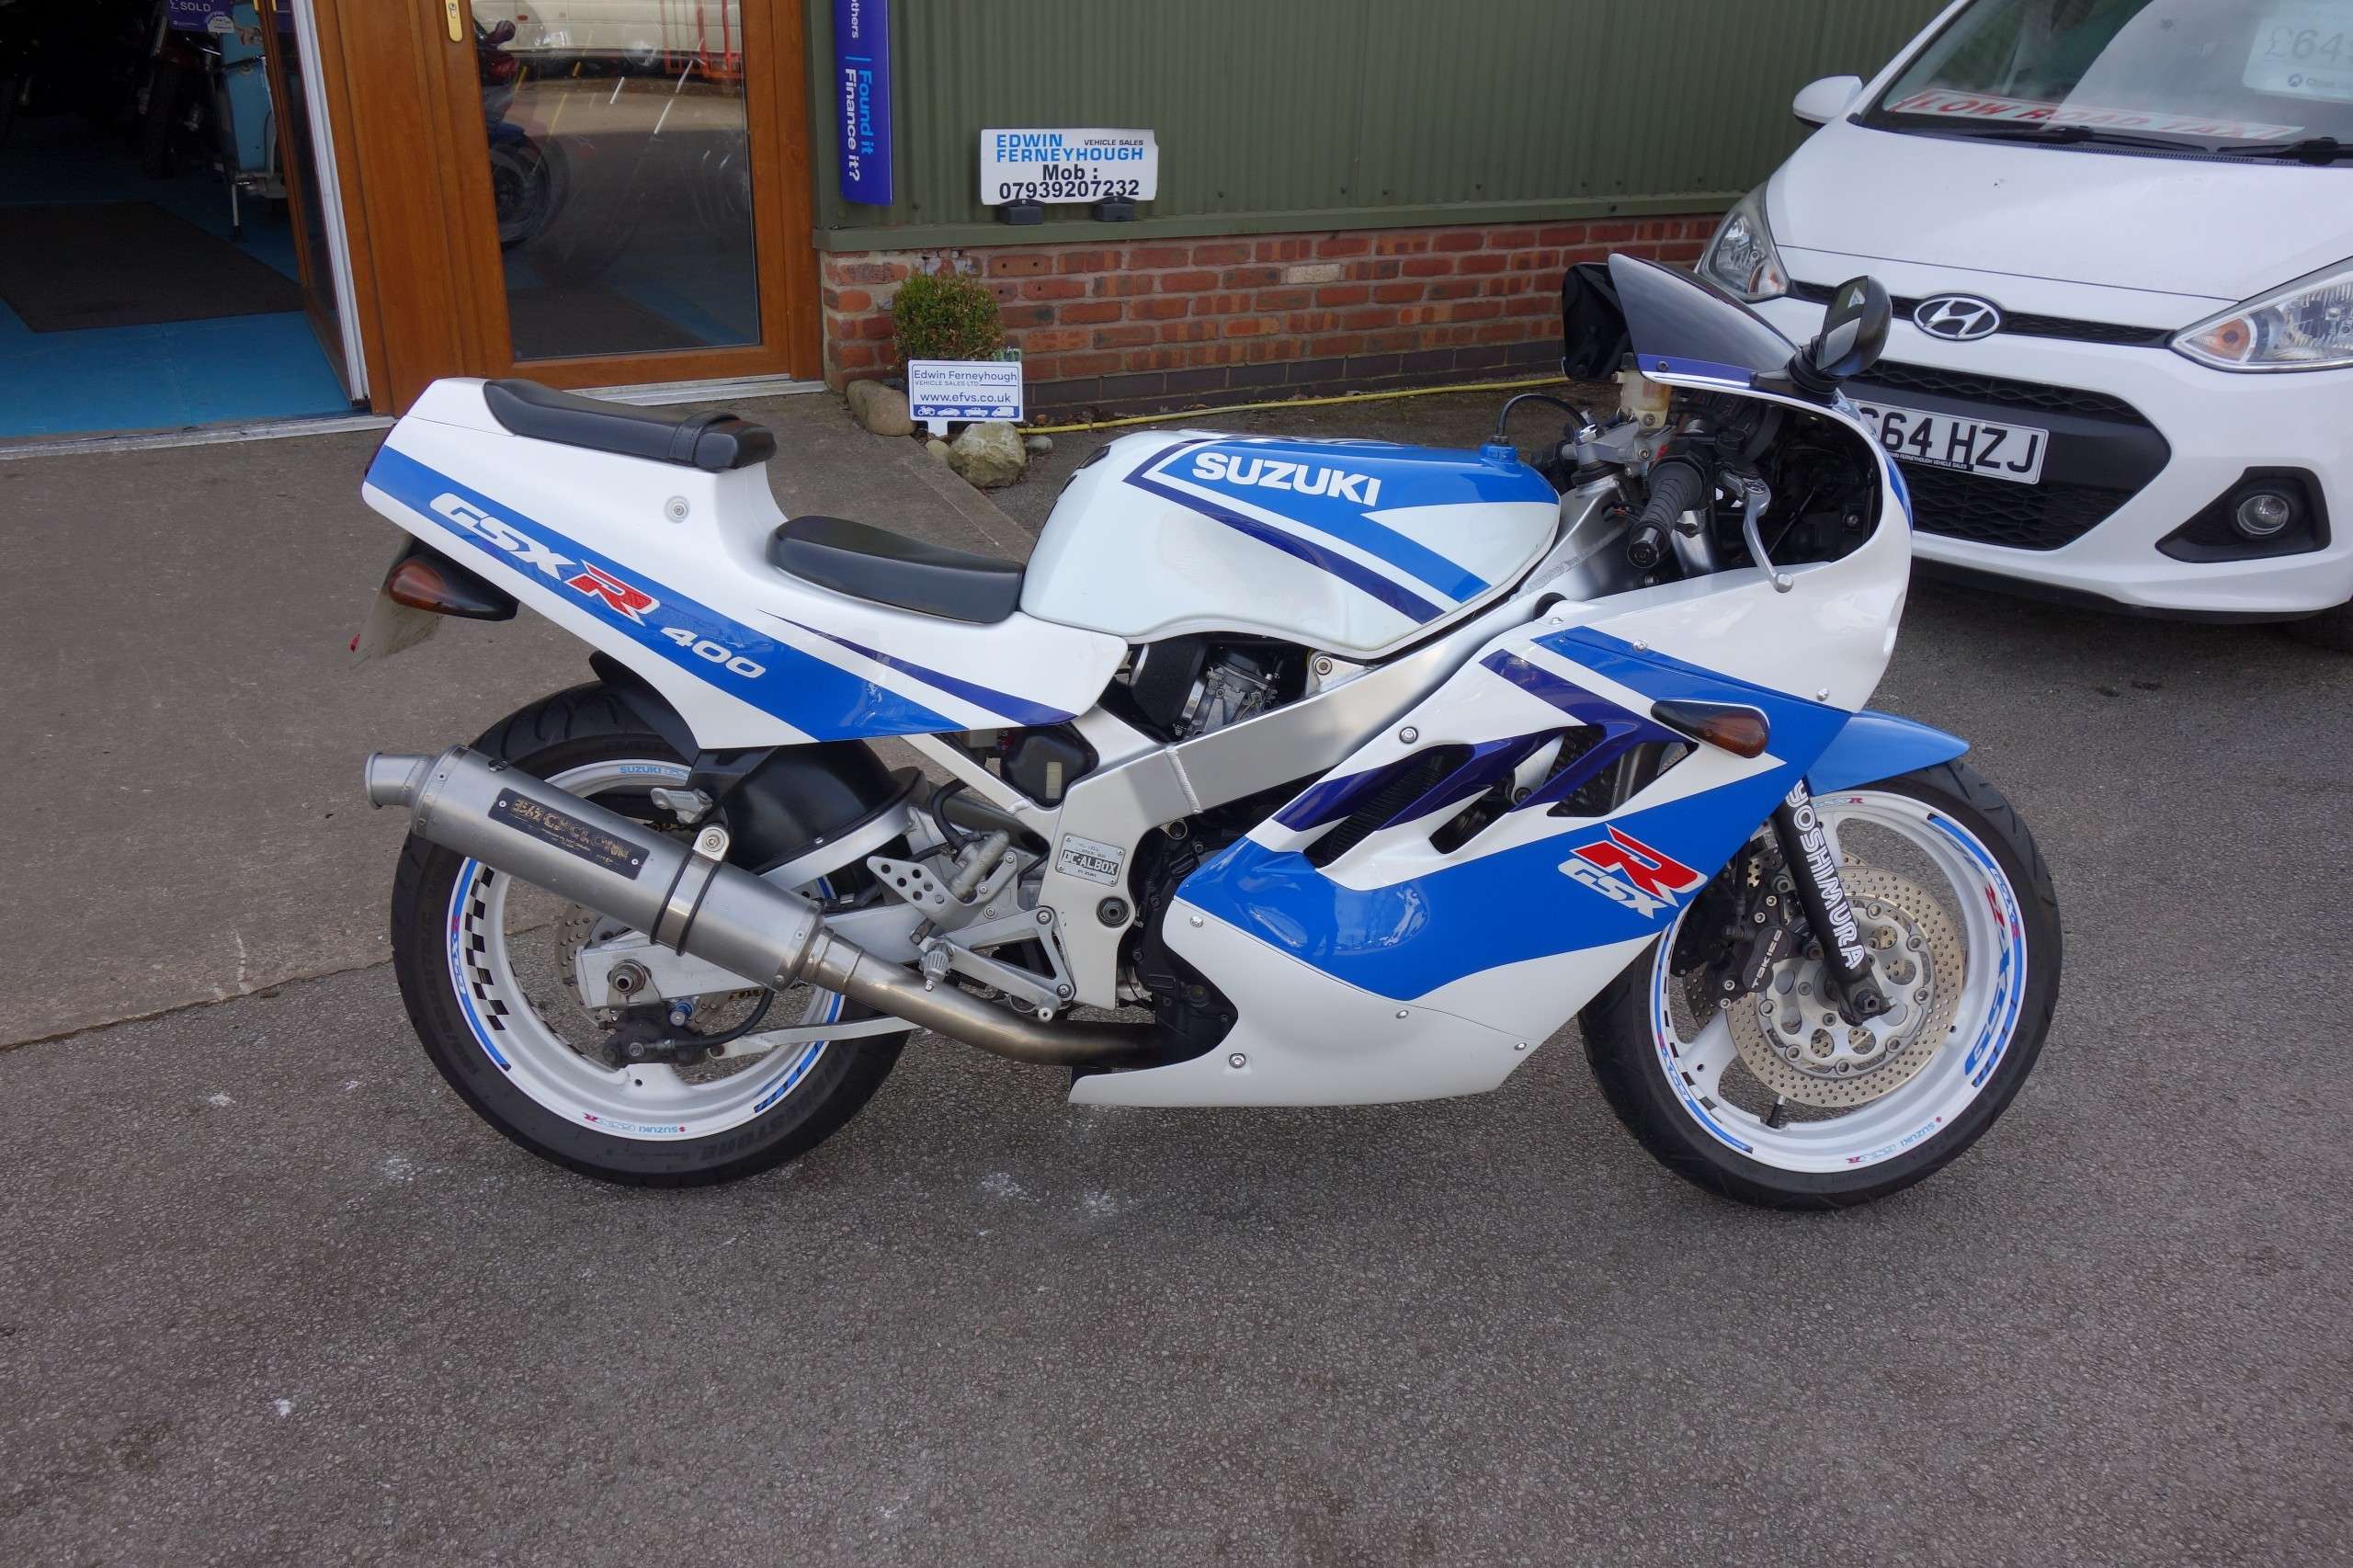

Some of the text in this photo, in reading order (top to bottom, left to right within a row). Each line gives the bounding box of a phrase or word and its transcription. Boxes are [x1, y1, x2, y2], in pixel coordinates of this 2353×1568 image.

[179, 2, 211, 12] SOLD
[850, 0, 859, 38] thers
[858, 70, 875, 154] Found it
[845, 68, 860, 182] Finance it?
[996, 134, 1063, 148] EDWIN
[996, 148, 1143, 162] FERNEYHOUGH
[1042, 164, 1086, 181] Mob
[999, 180, 1139, 199] 07939207232
[914, 370, 1017, 382] Edwin Ferneyhough
[920, 392, 1011, 403] www.efvs.co.uk
[1946, 422, 2039, 473] HZJ
[1192, 452, 1381, 507] SUZUKI
[660, 627, 766, 679] 400
[619, 766, 661, 774] SUZUKI
[1785, 779, 1868, 971] YOSHIMURA
[639, 1125, 678, 1133] SUZUKI
